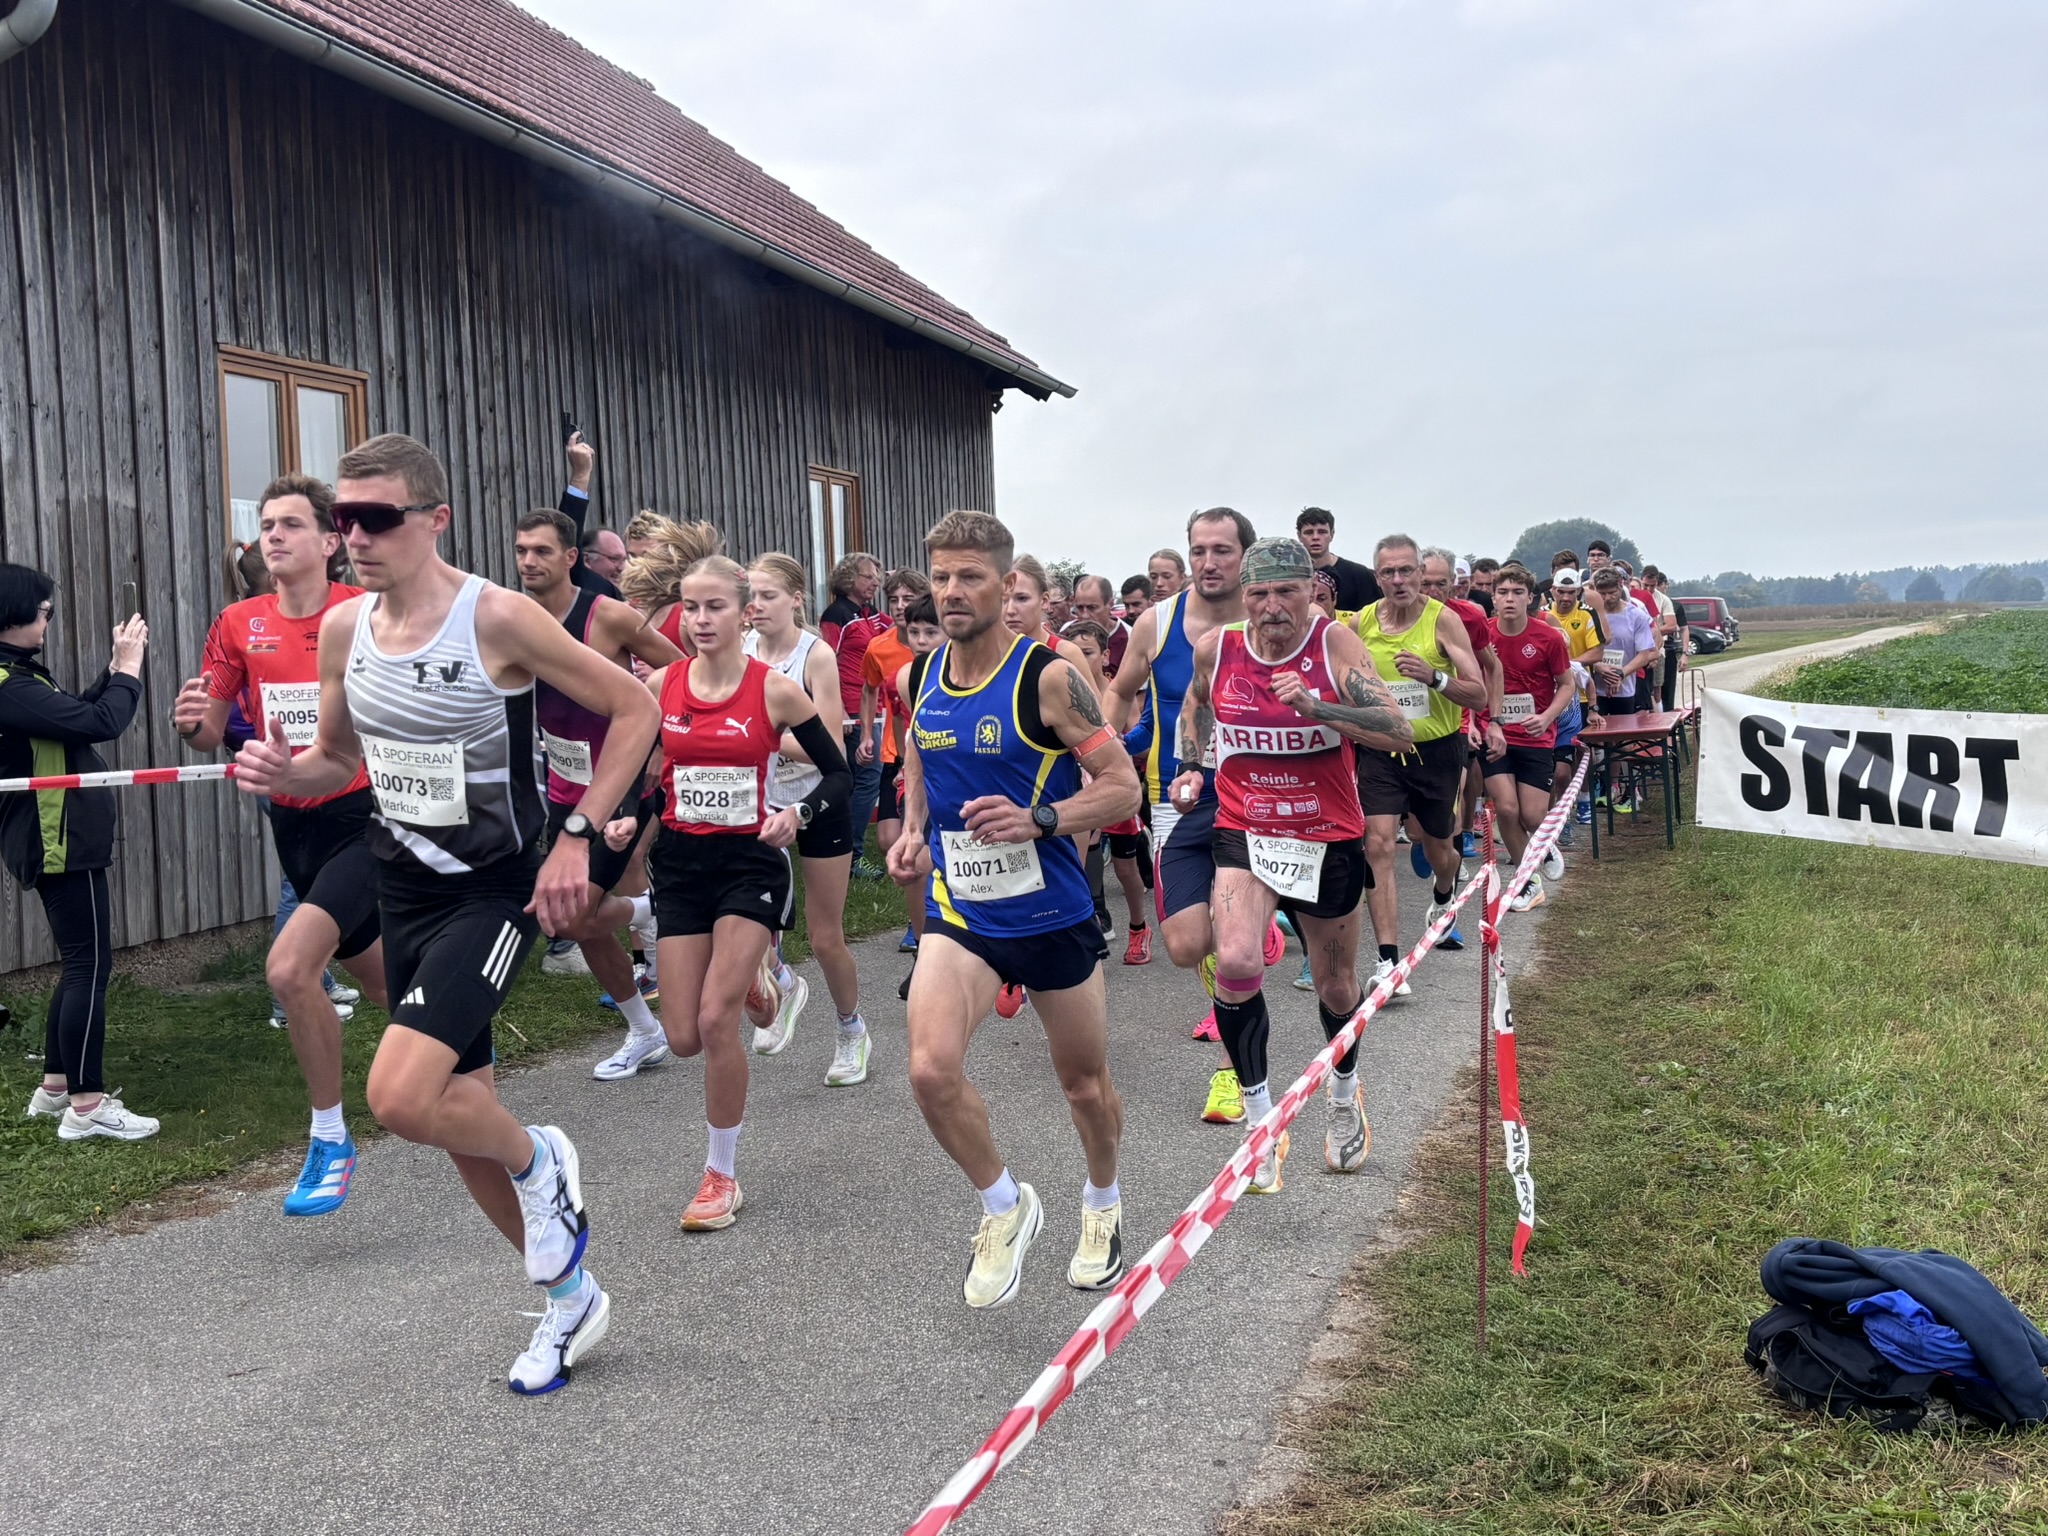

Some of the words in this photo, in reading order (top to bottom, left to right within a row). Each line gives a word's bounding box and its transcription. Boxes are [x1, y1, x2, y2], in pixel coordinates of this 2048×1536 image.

[413, 660, 463, 684] TSV
[1222, 727, 1327, 751] ARRIBA
[382, 747, 453, 765] SPOFERAN
[373, 770, 428, 797] 10073
[694, 772, 750, 782] SPOFERAN
[1249, 772, 1300, 785] Reinle
[1739, 714, 2020, 838] START
[380, 797, 420, 816] Markus
[681, 789, 730, 808] 5028
[1267, 839, 1319, 856] SPOFERAN
[953, 858, 1007, 878] 10071
[1255, 854, 1299, 877] 10077
[970, 884, 994, 894] Alex
